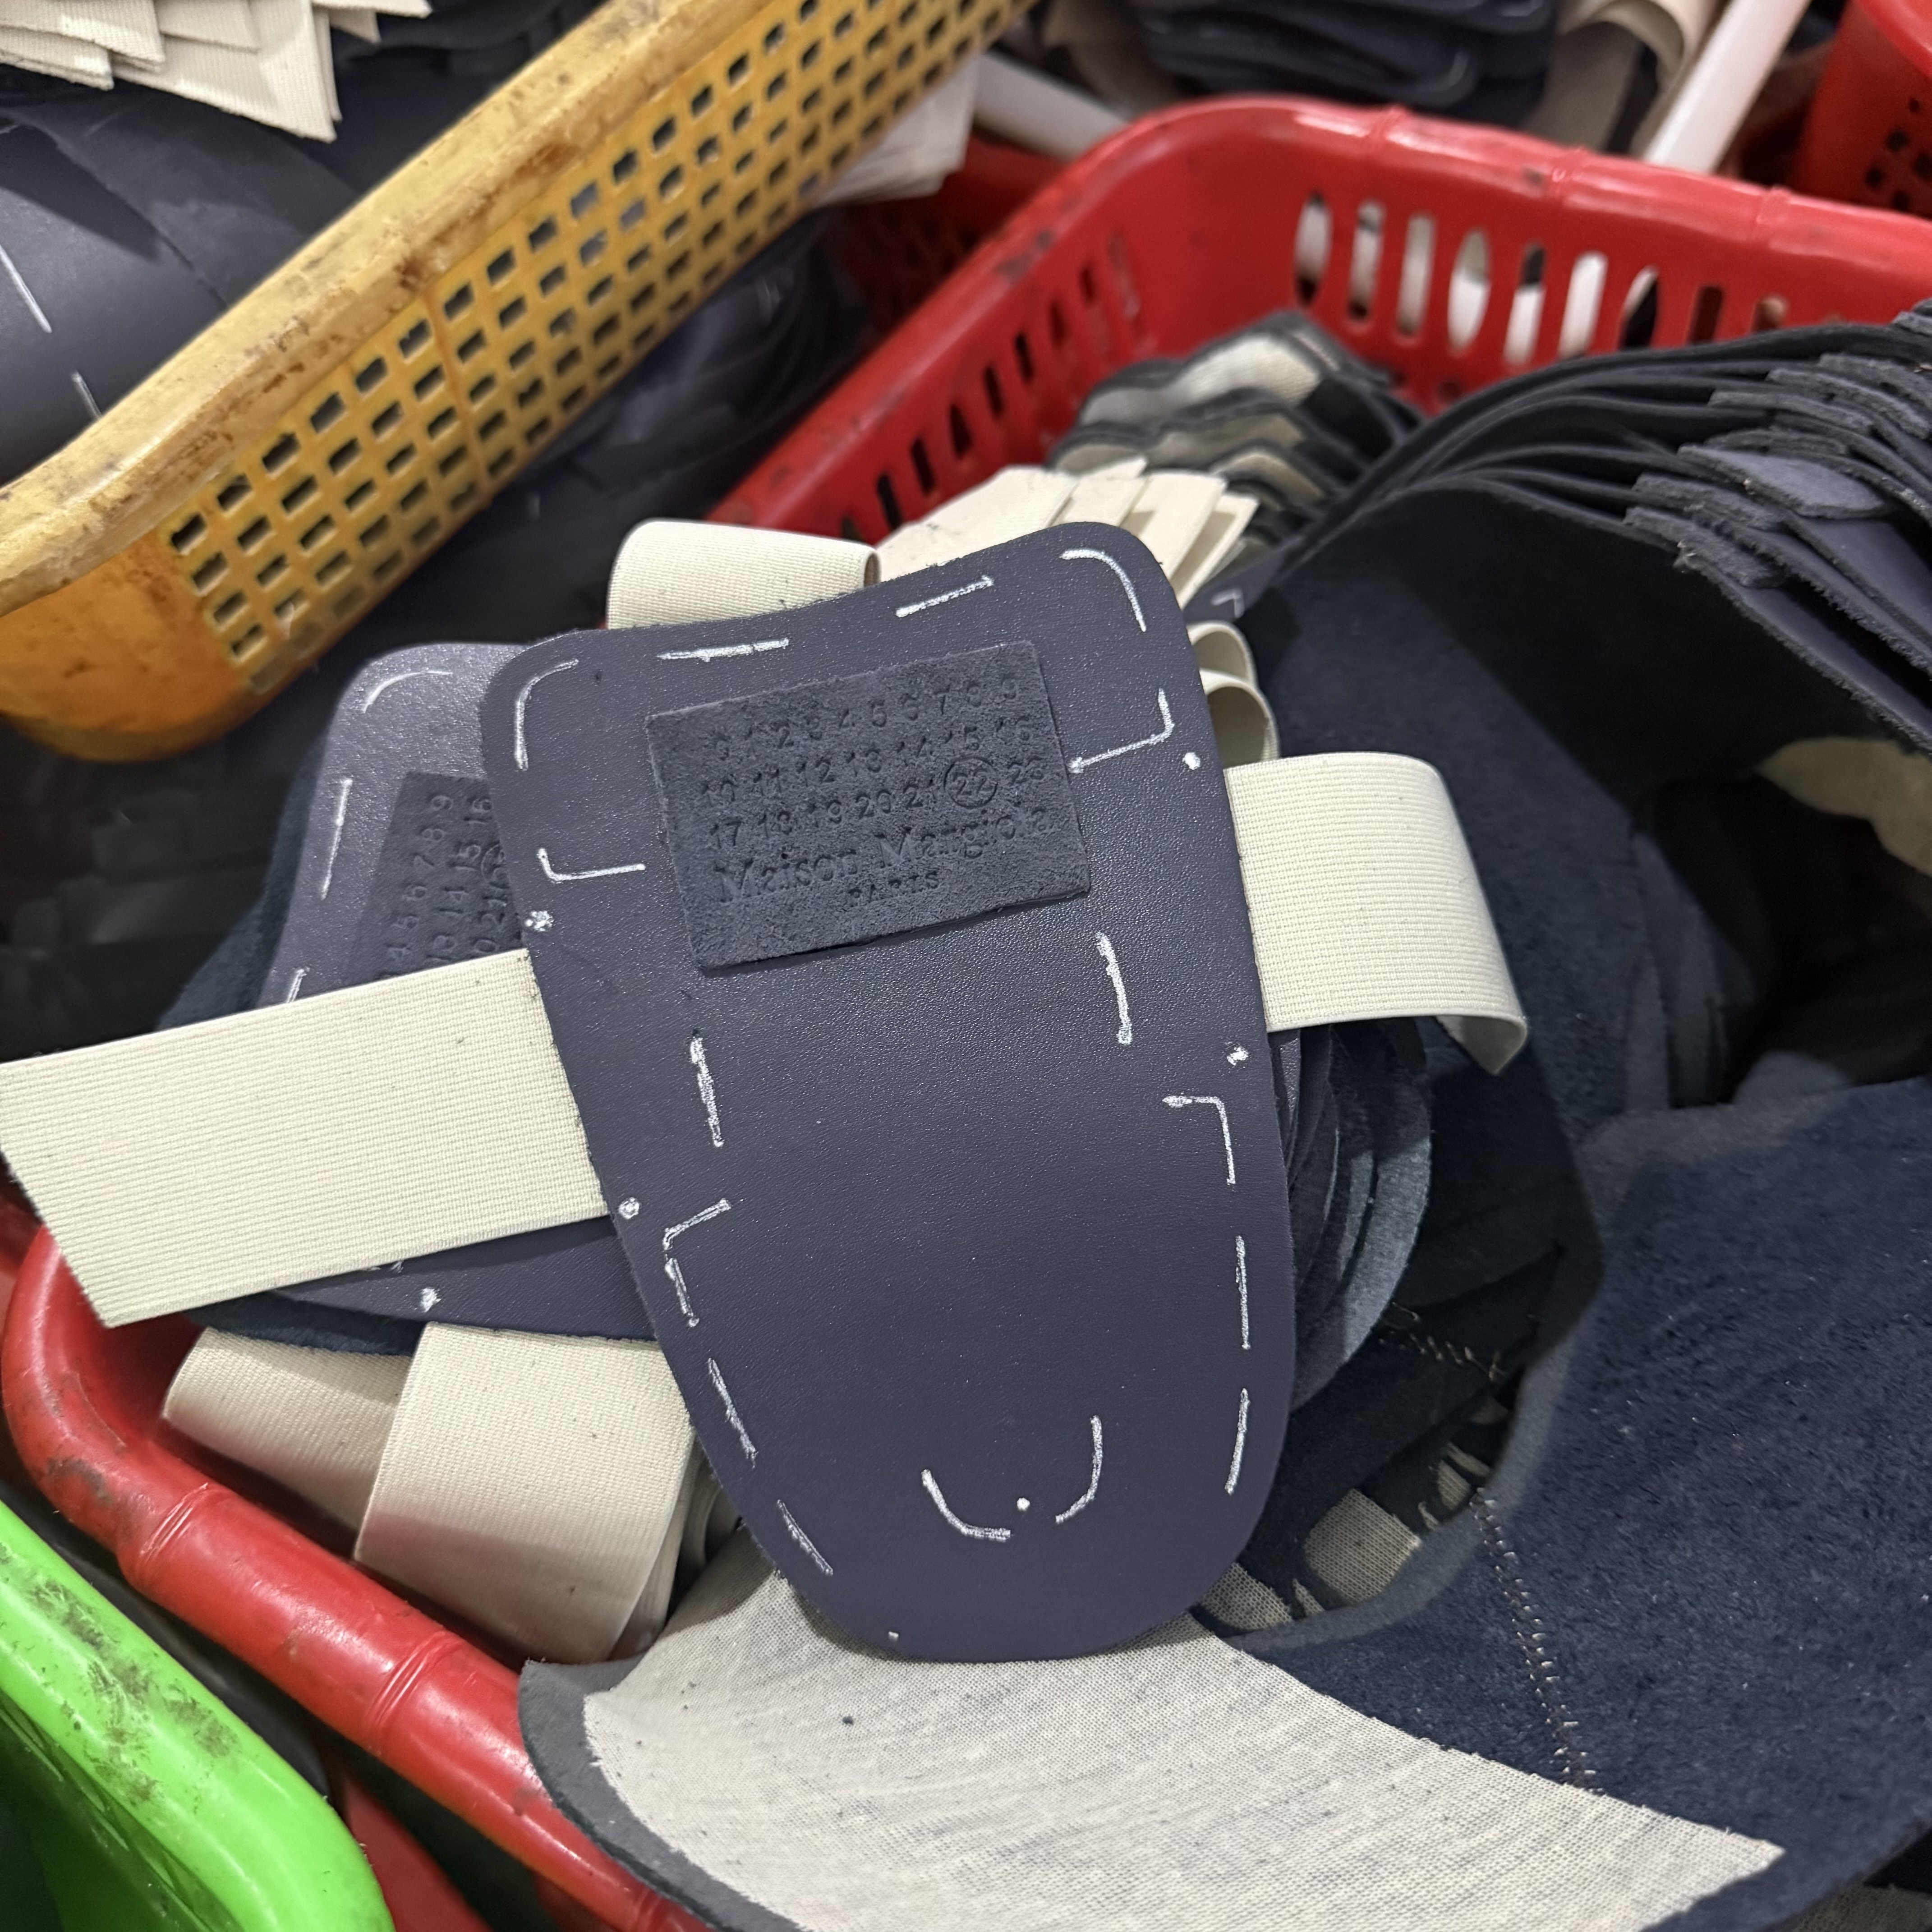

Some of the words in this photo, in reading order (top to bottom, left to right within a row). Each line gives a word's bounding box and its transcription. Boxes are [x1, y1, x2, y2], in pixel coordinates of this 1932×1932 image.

[769, 721, 795, 749] 2
[838, 708, 856, 733] 4
[869, 699, 888, 727] 5
[900, 692, 919, 722] 6
[932, 683, 951, 715] 7
[1002, 672, 1018, 699] 9
[701, 779, 737, 807] 10
[752, 768, 782, 797] 11
[795, 757, 835, 788] 12
[897, 734, 934, 768] 14
[946, 724, 980, 759] 15
[995, 714, 1032, 749] 16
[428, 793, 453, 813] 9
[463, 796, 493, 825] 16
[710, 818, 743, 849] 17
[758, 810, 793, 838] 18
[806, 798, 842, 830] 19
[856, 787, 893, 820] 20
[902, 776, 937, 811] 21
[951, 766, 989, 799] 22
[419, 825, 445, 842] 8
[449, 842, 482, 873] 15
[400, 881, 428, 901] 6
[713, 848, 857, 903] Maison
[847, 870, 941, 907] PARIS
[437, 886, 470, 915] 14
[479, 895, 508, 934] 21
[393, 912, 419, 930] 5
